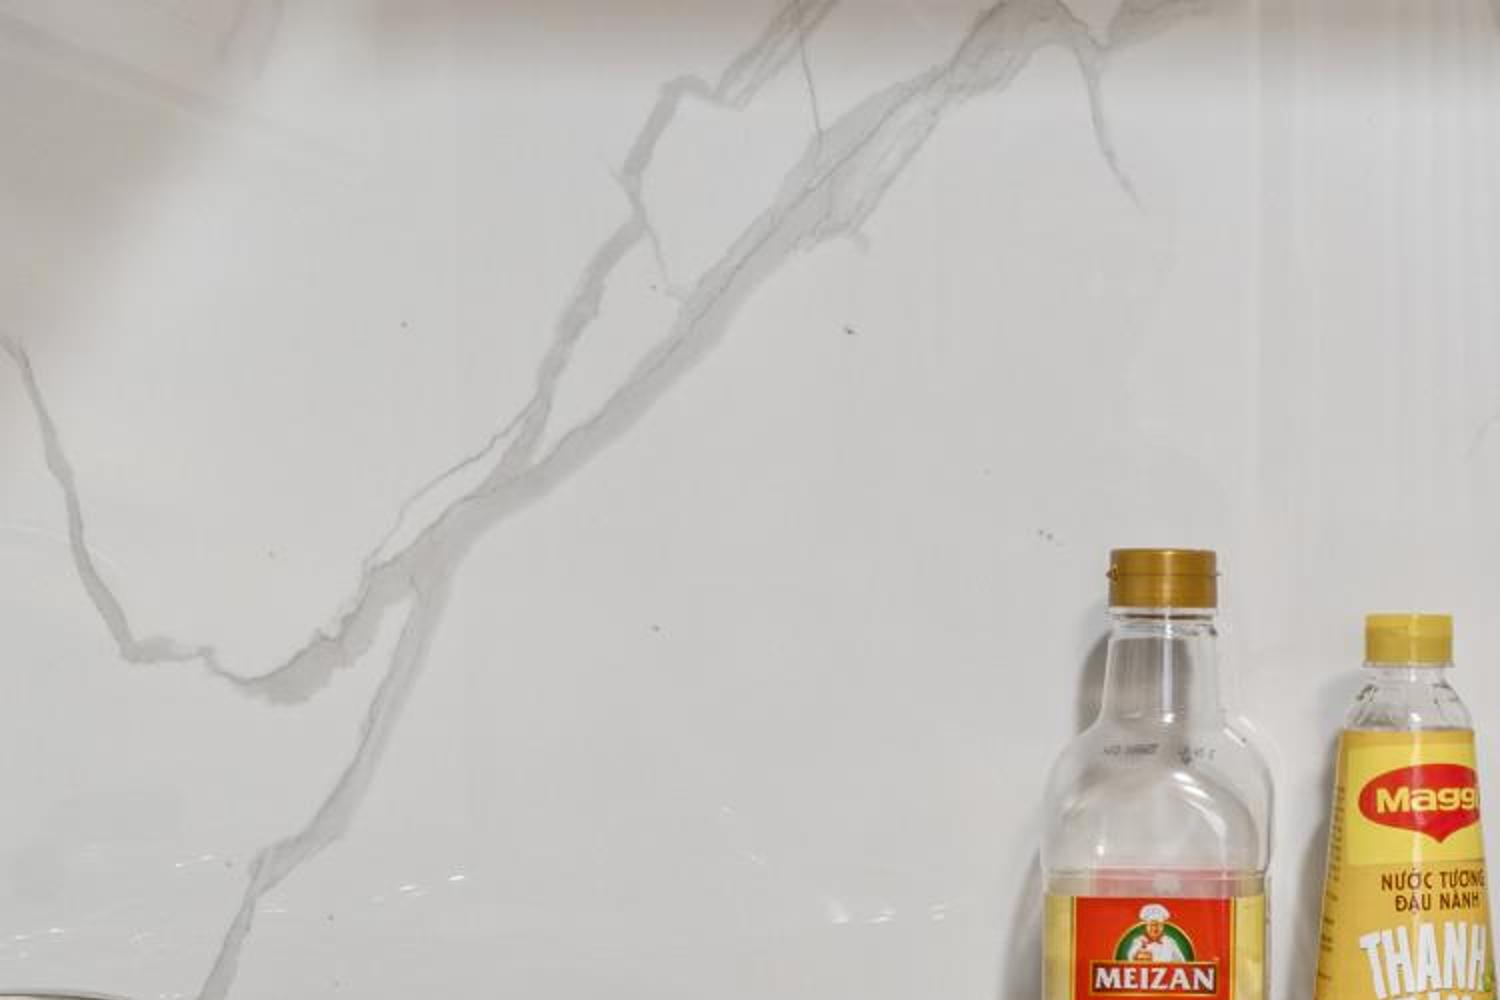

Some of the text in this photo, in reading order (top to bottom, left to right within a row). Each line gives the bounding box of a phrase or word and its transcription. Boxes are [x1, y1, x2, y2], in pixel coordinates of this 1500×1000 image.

[1375, 786, 1479, 814] Magg
[1381, 867, 1432, 891] NƯỚC
[1359, 921, 1486, 1000] THANH
[1094, 967, 1215, 991] MEIZAN
